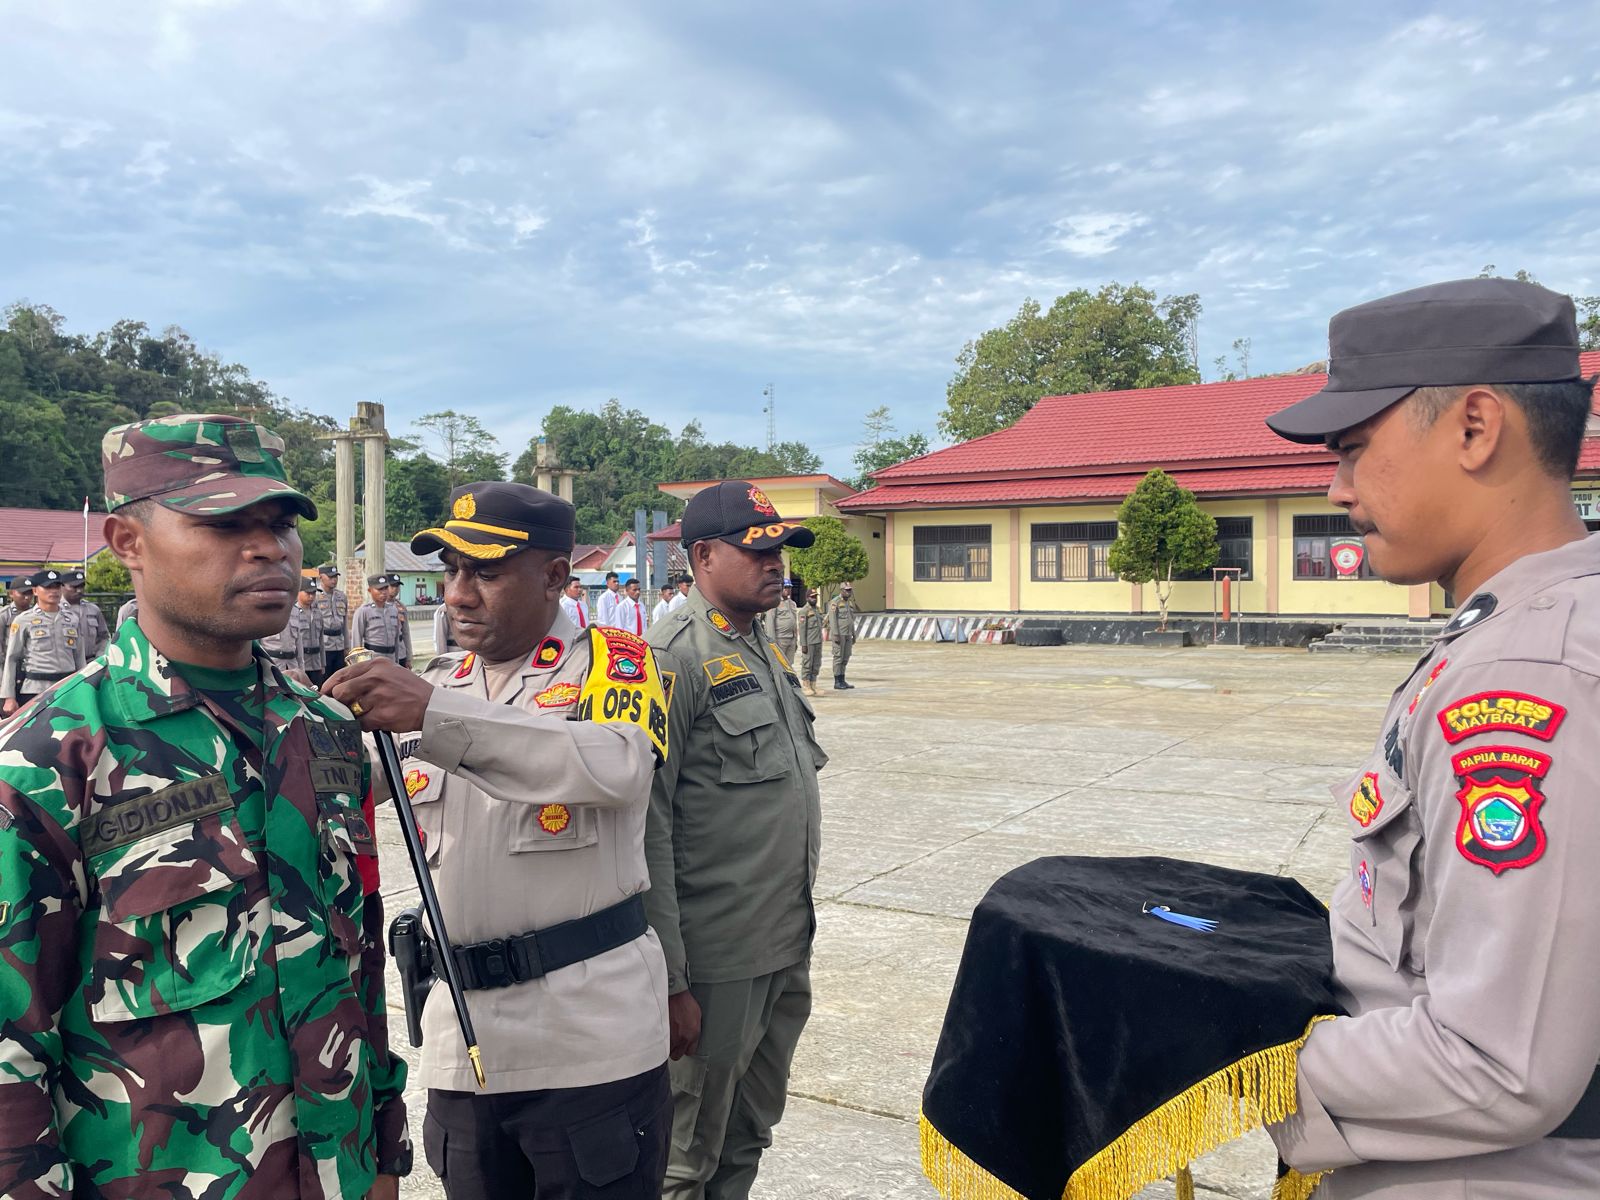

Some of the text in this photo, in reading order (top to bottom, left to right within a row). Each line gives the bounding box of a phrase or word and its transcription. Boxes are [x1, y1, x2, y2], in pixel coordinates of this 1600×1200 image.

[603, 688, 642, 722] OPS
[1446, 698, 1553, 721] POLRES
[1454, 713, 1540, 732] MAYBRAT
[1460, 752, 1541, 769] PAPUA BARAT
[320, 766, 349, 785] TNI
